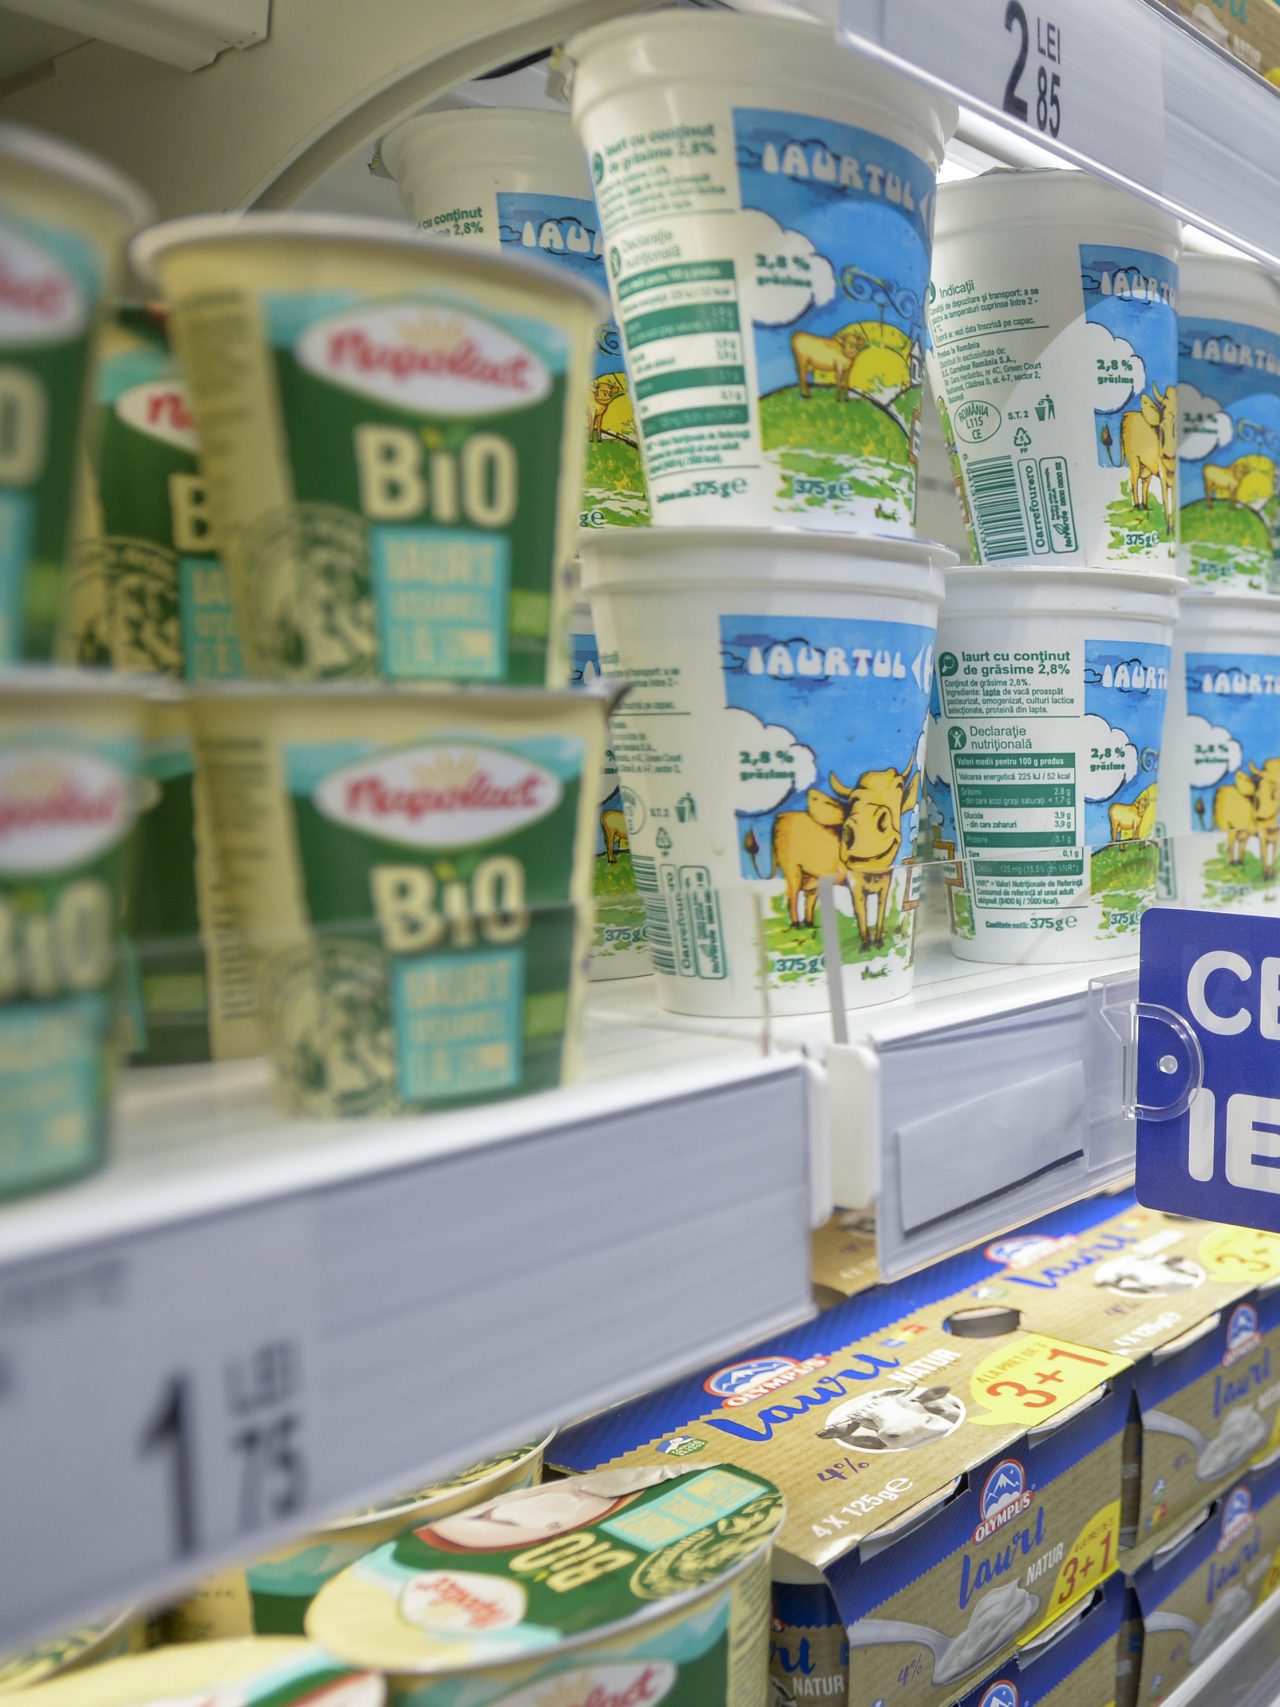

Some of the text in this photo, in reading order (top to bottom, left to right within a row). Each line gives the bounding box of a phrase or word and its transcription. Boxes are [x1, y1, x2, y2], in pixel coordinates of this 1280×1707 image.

[1037, 16, 1061, 65] LEI
[1003, 0, 1028, 122] 2
[1036, 65, 1061, 139] 85
[762, 141, 915, 212] IAURTUL
[453, 220, 484, 237] 2,8%
[755, 253, 788, 270] 2,8
[1096, 359, 1133, 372] 2,8 %
[972, 428, 983, 440] CE
[747, 645, 907, 679] IAURTUL
[961, 651, 991, 662] Iaurt
[993, 652, 1010, 661] cu
[963, 663, 1070, 677] de grăsime 2,8%
[970, 679, 978, 687] de
[1015, 705, 1027, 713] din
[739, 750, 795, 768] 2,8 %
[1019, 757, 1033, 766] 100
[1033, 759, 1039, 767] g
[1040, 757, 1064, 767] produs
[1090, 747, 1126, 760] 2,8 %
[1018, 772, 1031, 780] 225
[1046, 772, 1056, 780] 52
[1054, 811, 1066, 820] 3,9
[1066, 812, 1072, 821] g
[1054, 820, 1066, 829] 3,9
[1066, 822, 1072, 830] g
[1062, 849, 1080, 859] 0,1 g
[886, 1348, 962, 1385] NATUR
[724, 1356, 829, 1408] OLYMPUS
[136, 1366, 199, 1558] 1
[816, 1457, 871, 1482] 4%
[974, 1489, 1033, 1542] OLYMPUS
[811, 1521, 831, 1540] 4
[827, 1511, 850, 1530] X
[1026, 1541, 1065, 1586] NATUR
[791, 1674, 845, 1698] NATUR
